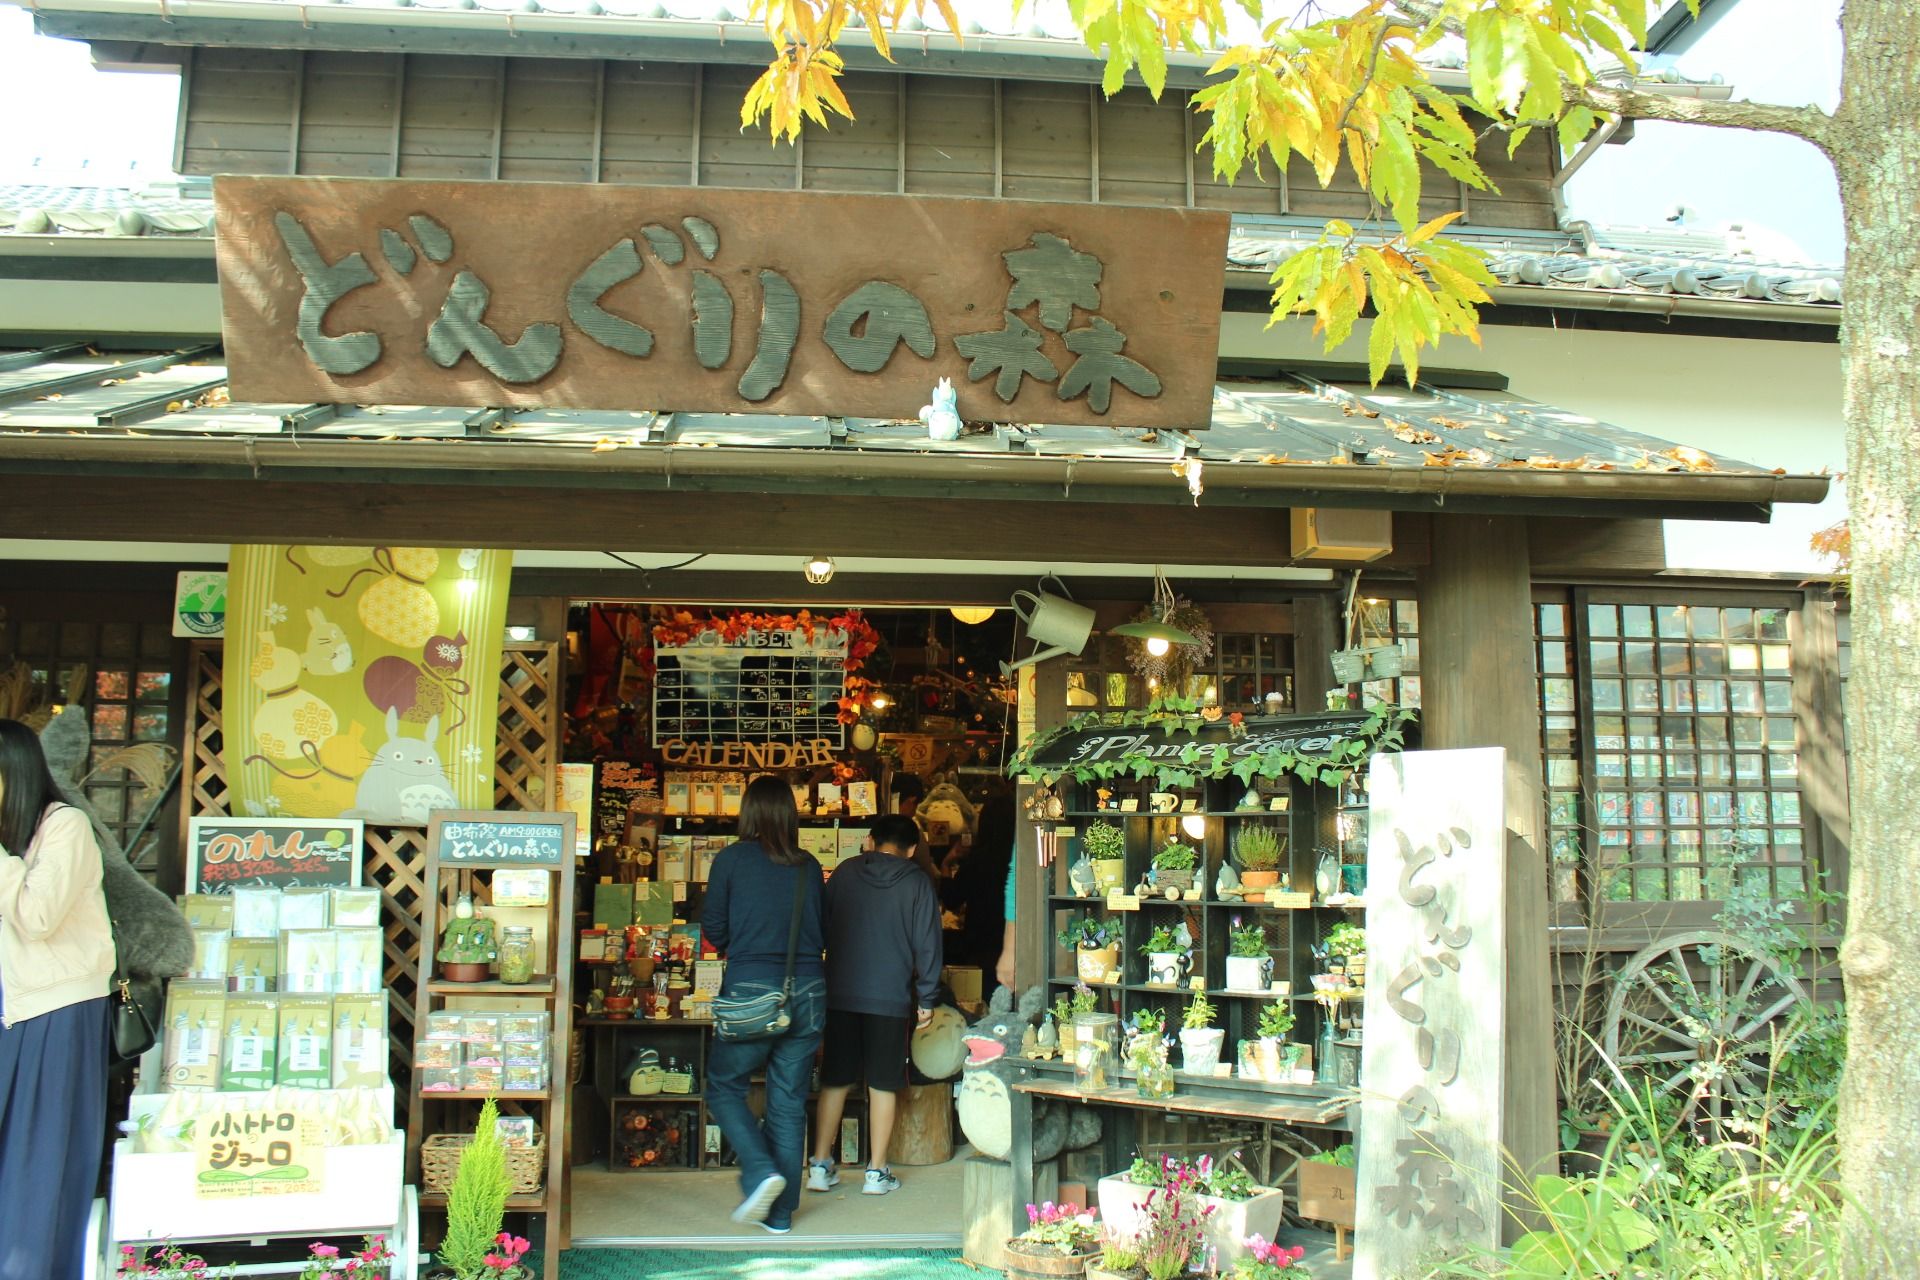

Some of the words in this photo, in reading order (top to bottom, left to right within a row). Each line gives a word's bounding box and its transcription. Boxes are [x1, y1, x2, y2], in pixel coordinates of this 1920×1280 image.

[274, 209, 1164, 413] どんぐりの森
[661, 738, 837, 769] CALENDAR
[205, 829, 314, 864] のれん
[452, 838, 541, 858] どんぐりの森
[1375, 826, 1485, 1238] どんぐりの森
[210, 1112, 295, 1137] 小トトロ
[209, 1140, 291, 1170] ジョーロ
